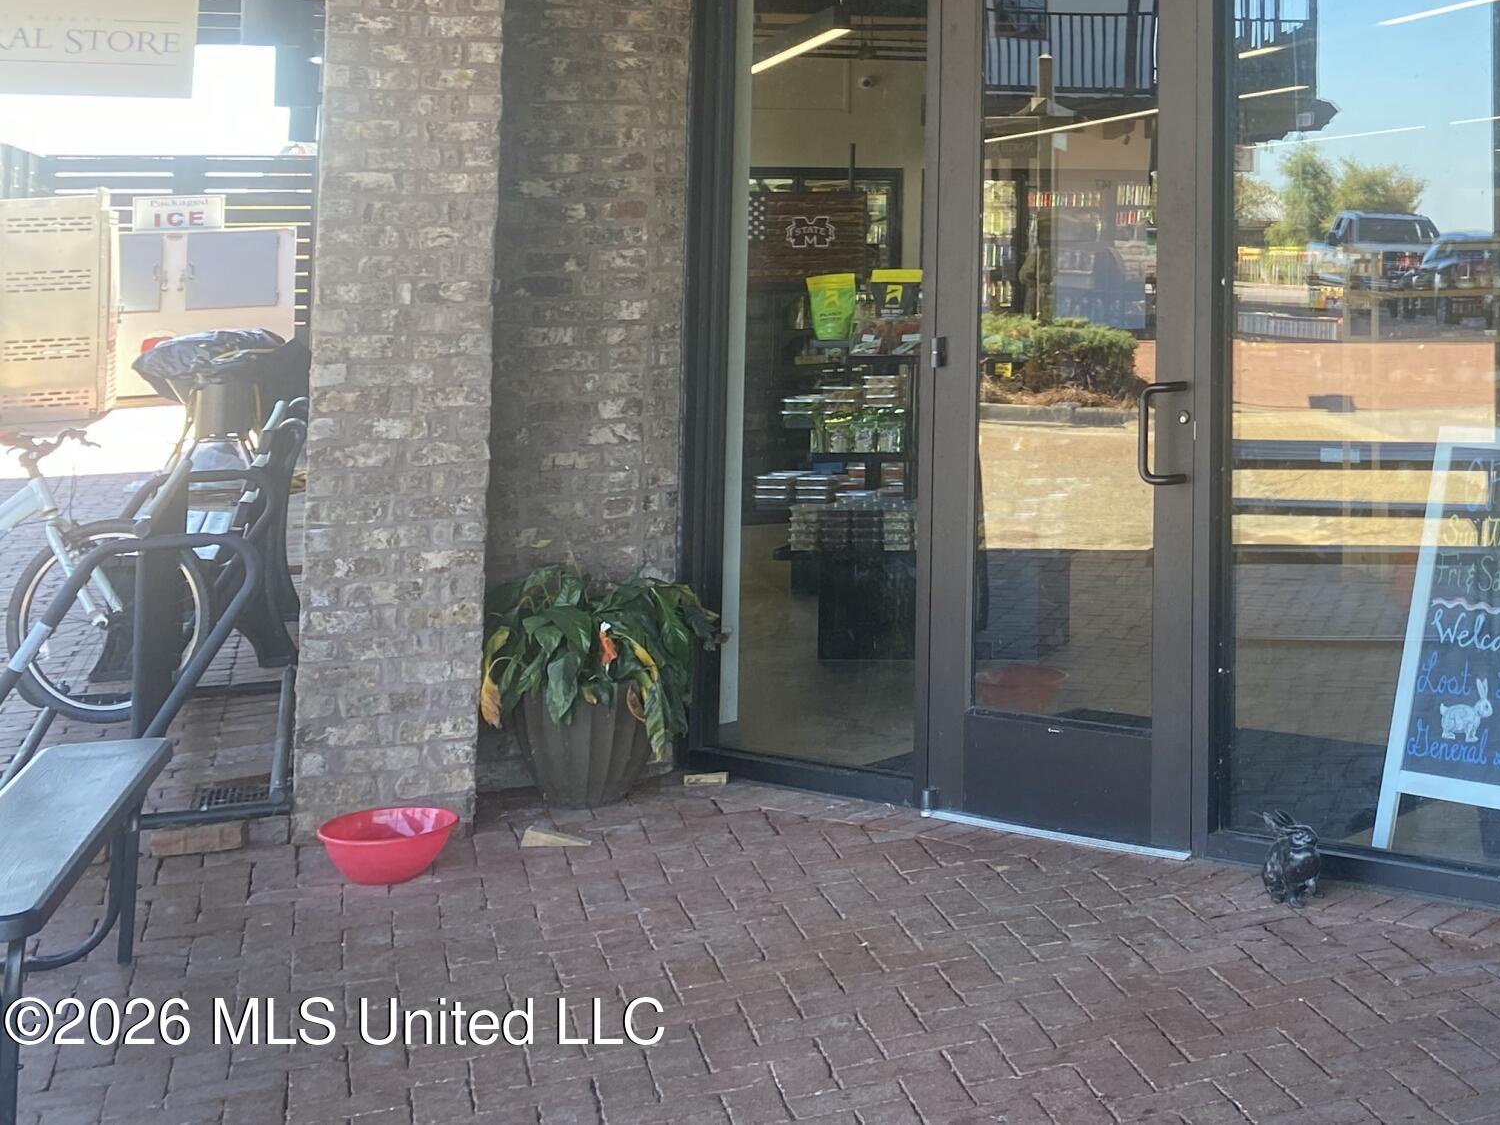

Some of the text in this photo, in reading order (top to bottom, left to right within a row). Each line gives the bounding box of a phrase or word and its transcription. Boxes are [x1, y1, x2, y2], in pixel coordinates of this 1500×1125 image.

[0, 27, 182, 56] AL STORE
[153, 210, 205, 228] ICE
[1416, 651, 1473, 696] Lost
[1405, 718, 1490, 766] General
